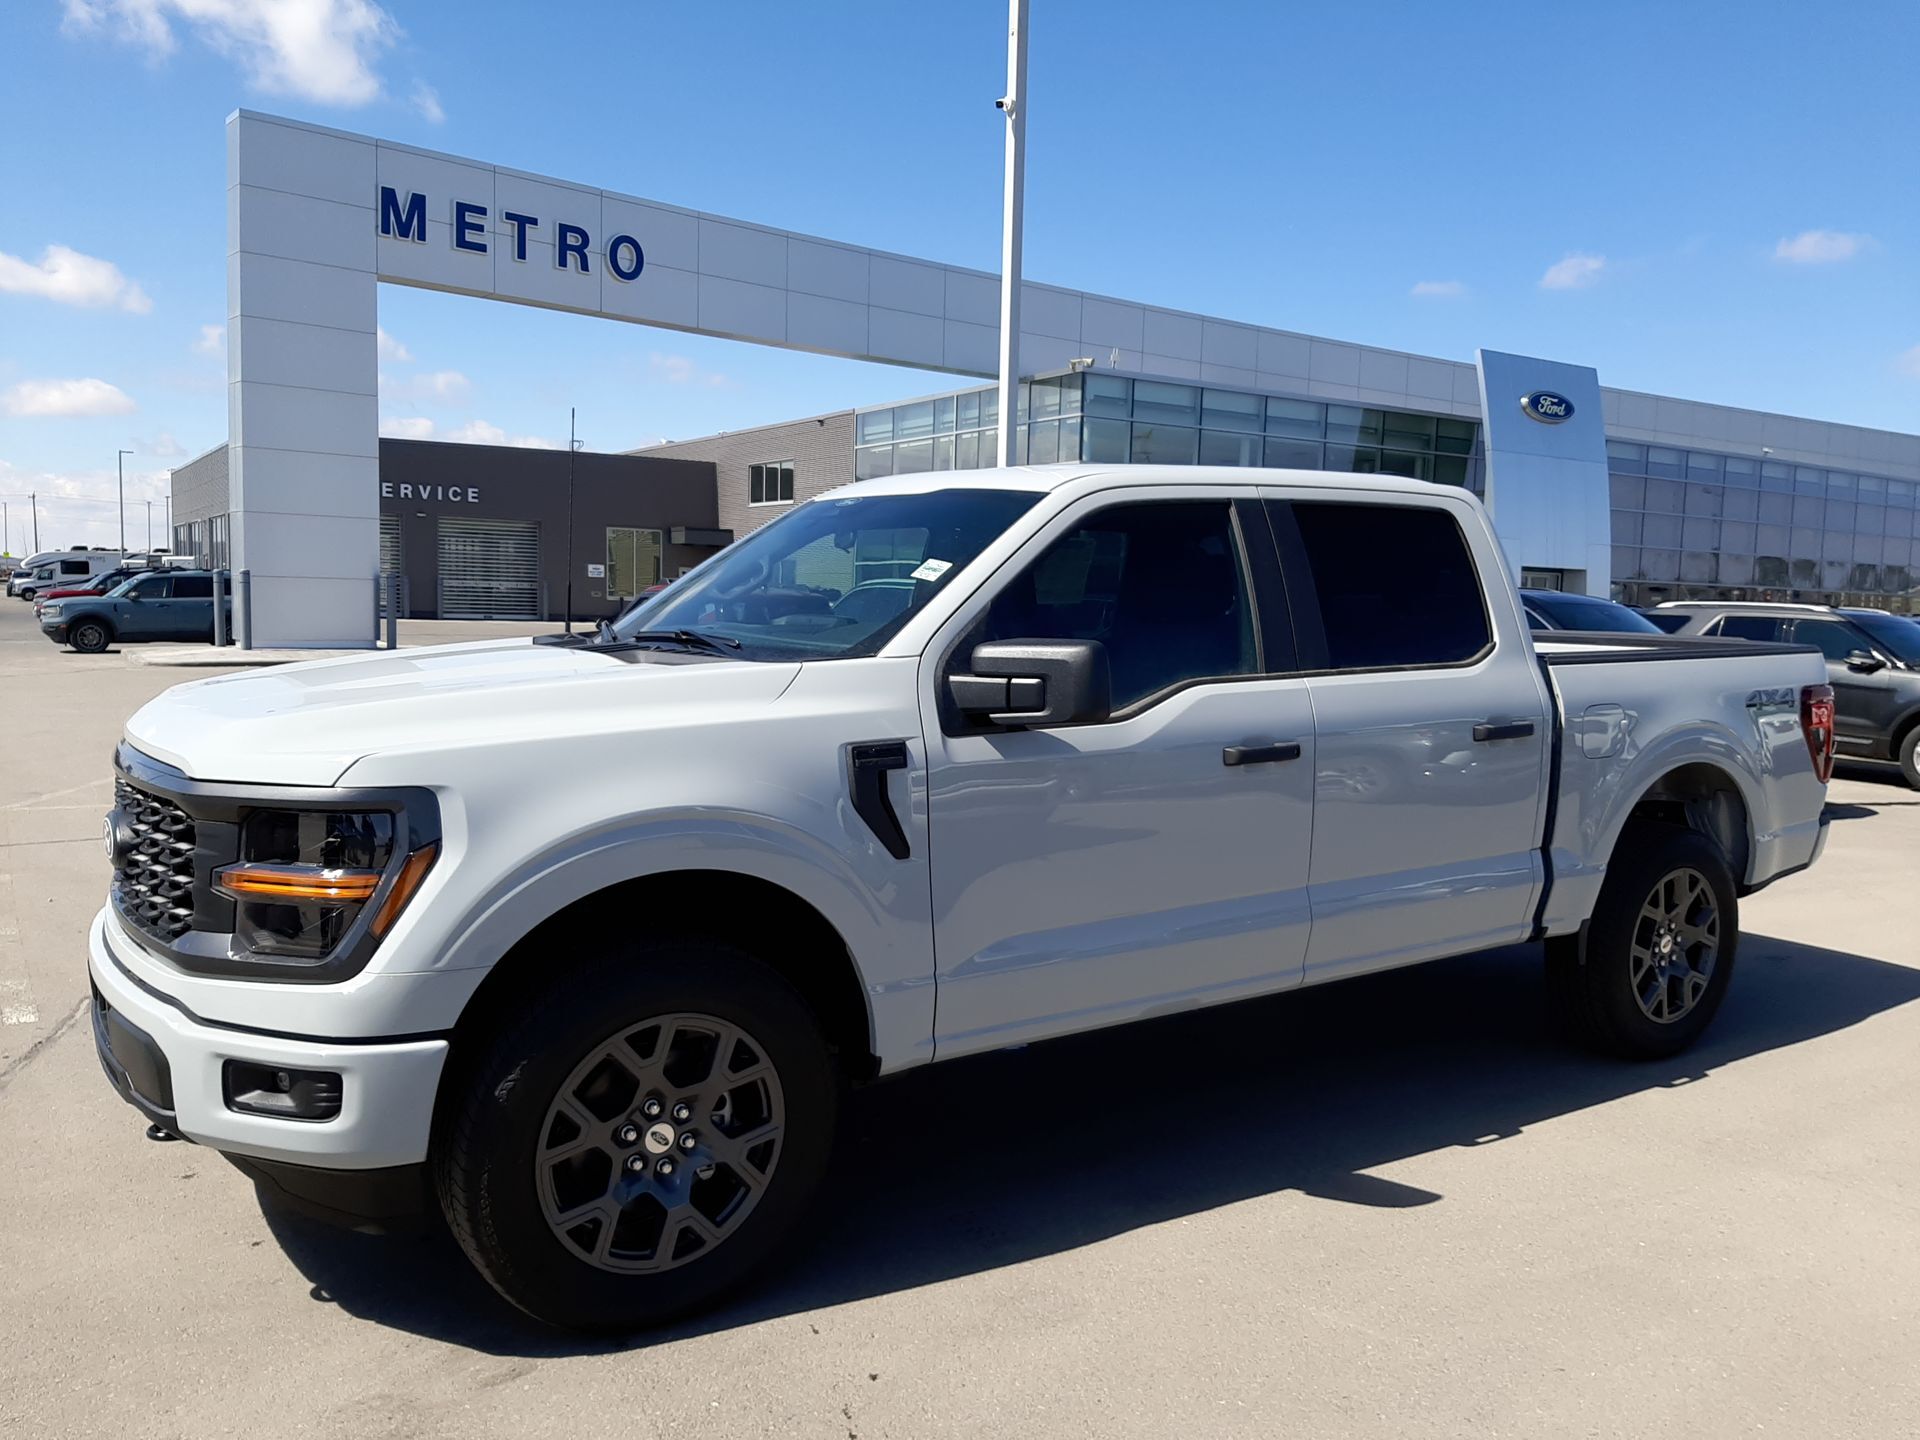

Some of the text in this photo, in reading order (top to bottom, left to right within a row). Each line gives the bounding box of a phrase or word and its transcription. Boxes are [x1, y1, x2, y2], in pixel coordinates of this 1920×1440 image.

[378, 185, 646, 283] METRO
[1537, 395, 1566, 416] Ford
[381, 482, 480, 503] ERVICE
